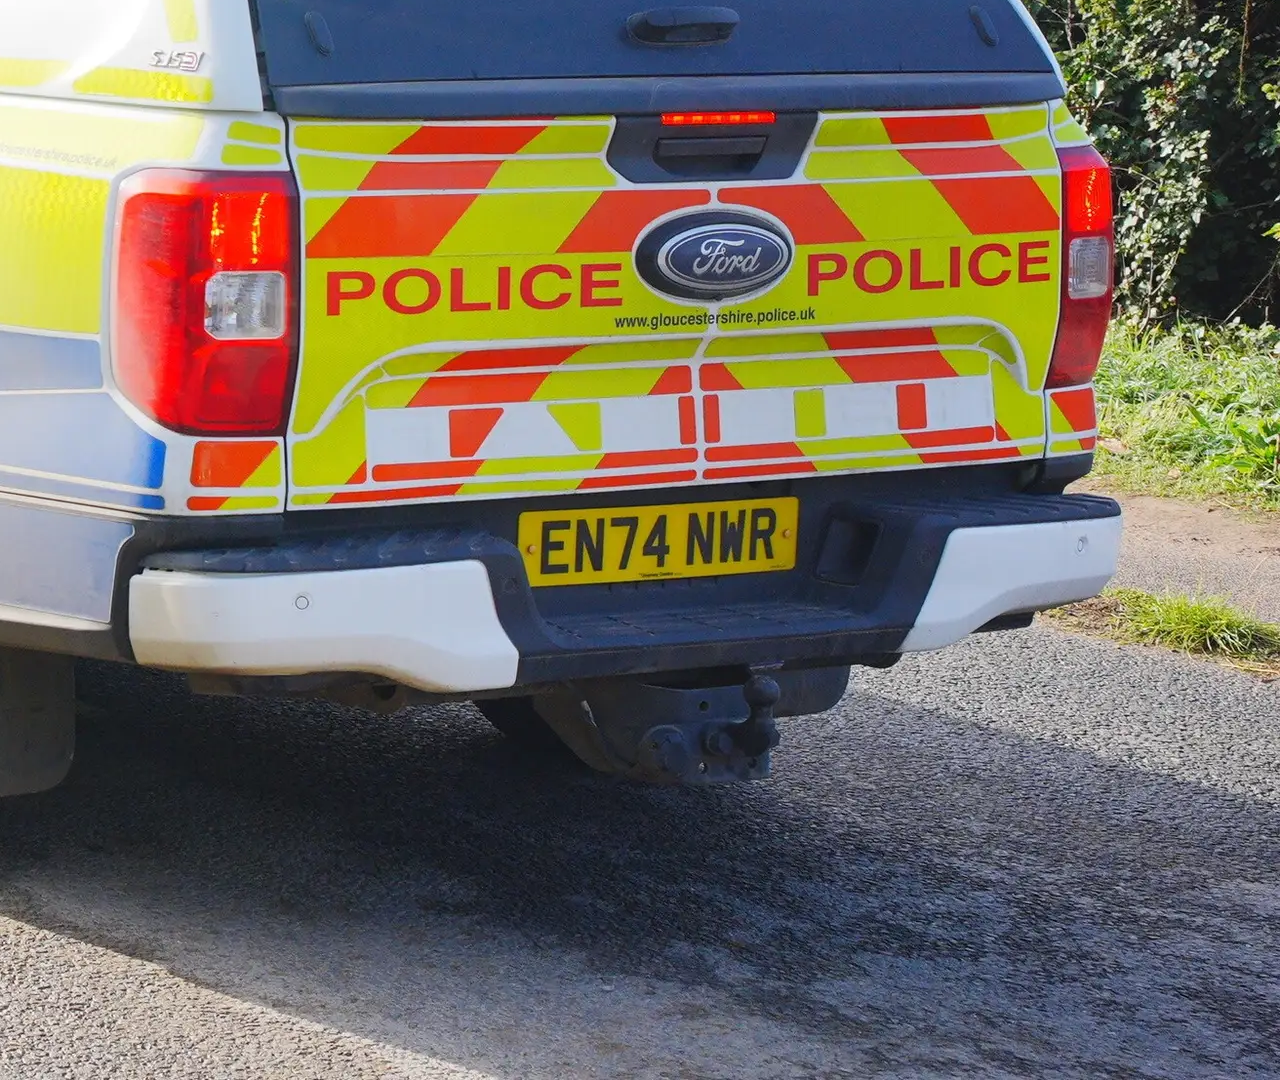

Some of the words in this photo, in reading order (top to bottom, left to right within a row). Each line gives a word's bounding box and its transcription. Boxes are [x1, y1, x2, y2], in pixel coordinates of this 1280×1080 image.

[693, 238, 761, 275] Ford
[807, 241, 1050, 297] POLICE
[326, 263, 623, 316] POLICE
[614, 306, 816, 330] www.gloucestershire.police.uk
[540, 516, 670, 575] EN74
[686, 507, 777, 566] NWR
